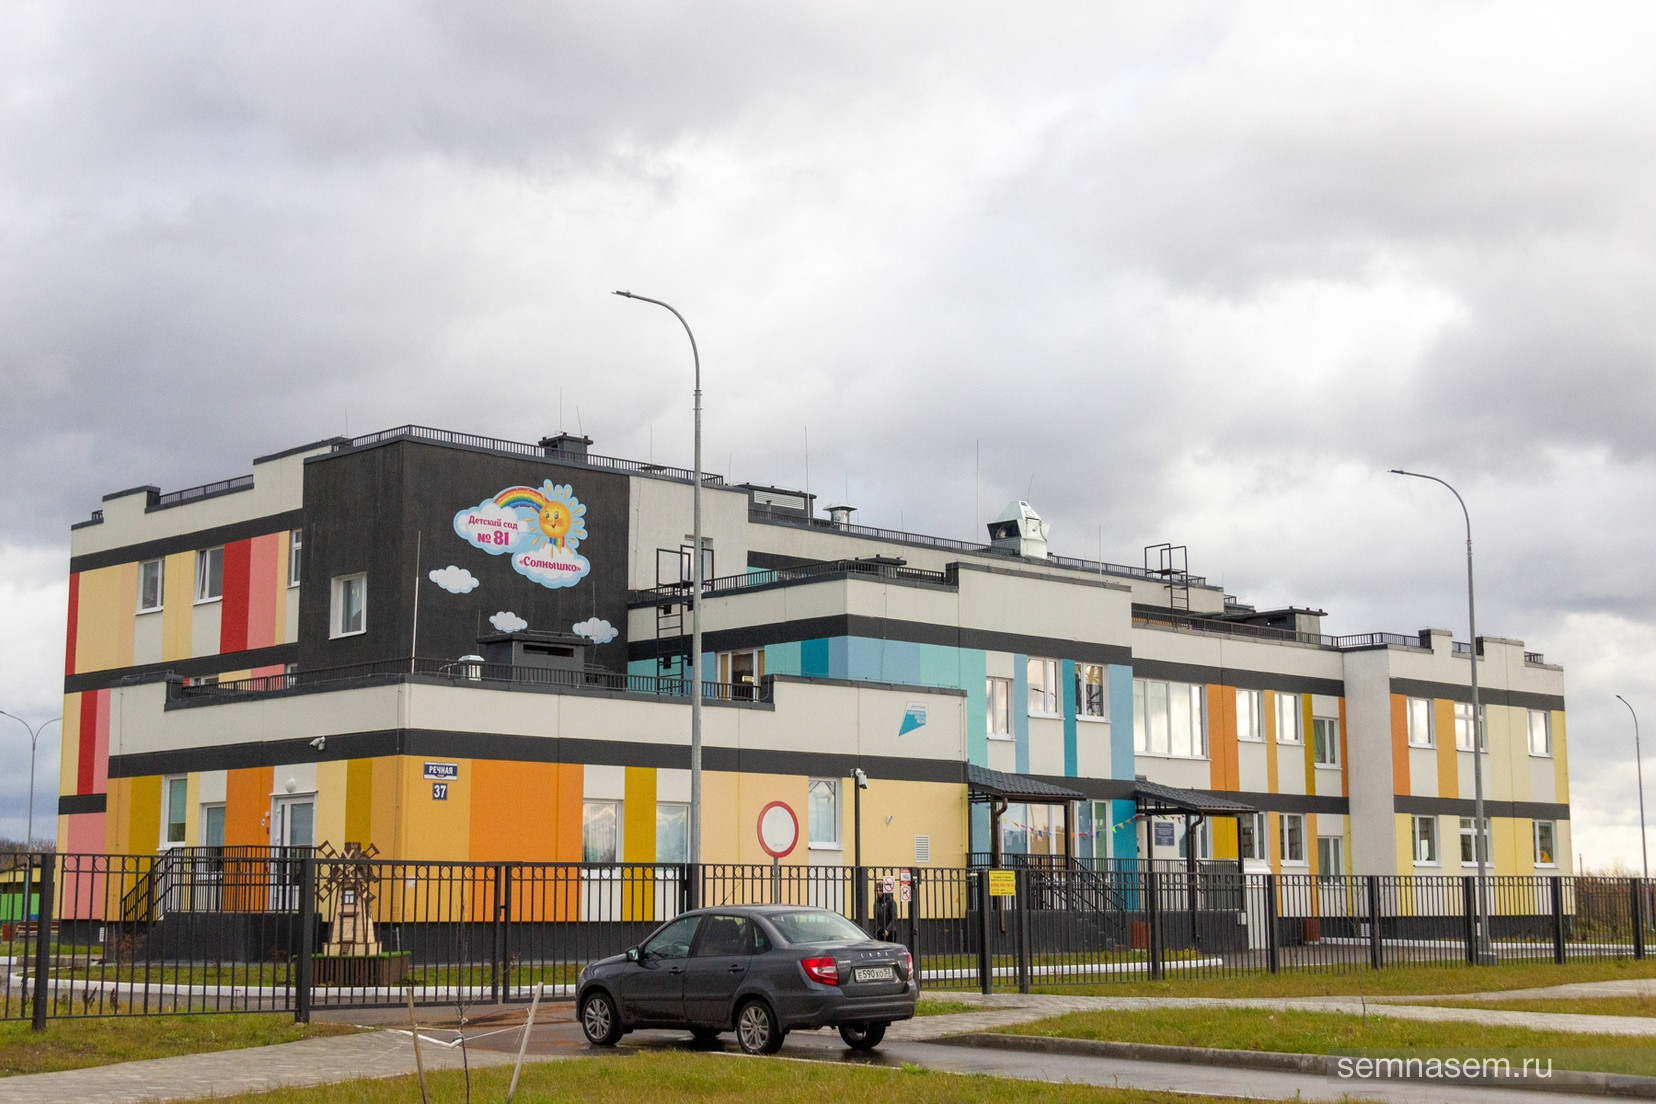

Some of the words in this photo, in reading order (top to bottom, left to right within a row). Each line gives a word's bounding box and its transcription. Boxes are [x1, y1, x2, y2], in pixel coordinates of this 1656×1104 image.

[468, 515, 502, 527] Детский
[503, 521, 518, 530] сад
[477, 533, 492, 544] №
[493, 530, 509, 546] 81
[519, 556, 581, 572] «Солнышко»
[428, 765, 454, 775] РЕЧНАЯ
[433, 784, 447, 798] 37
